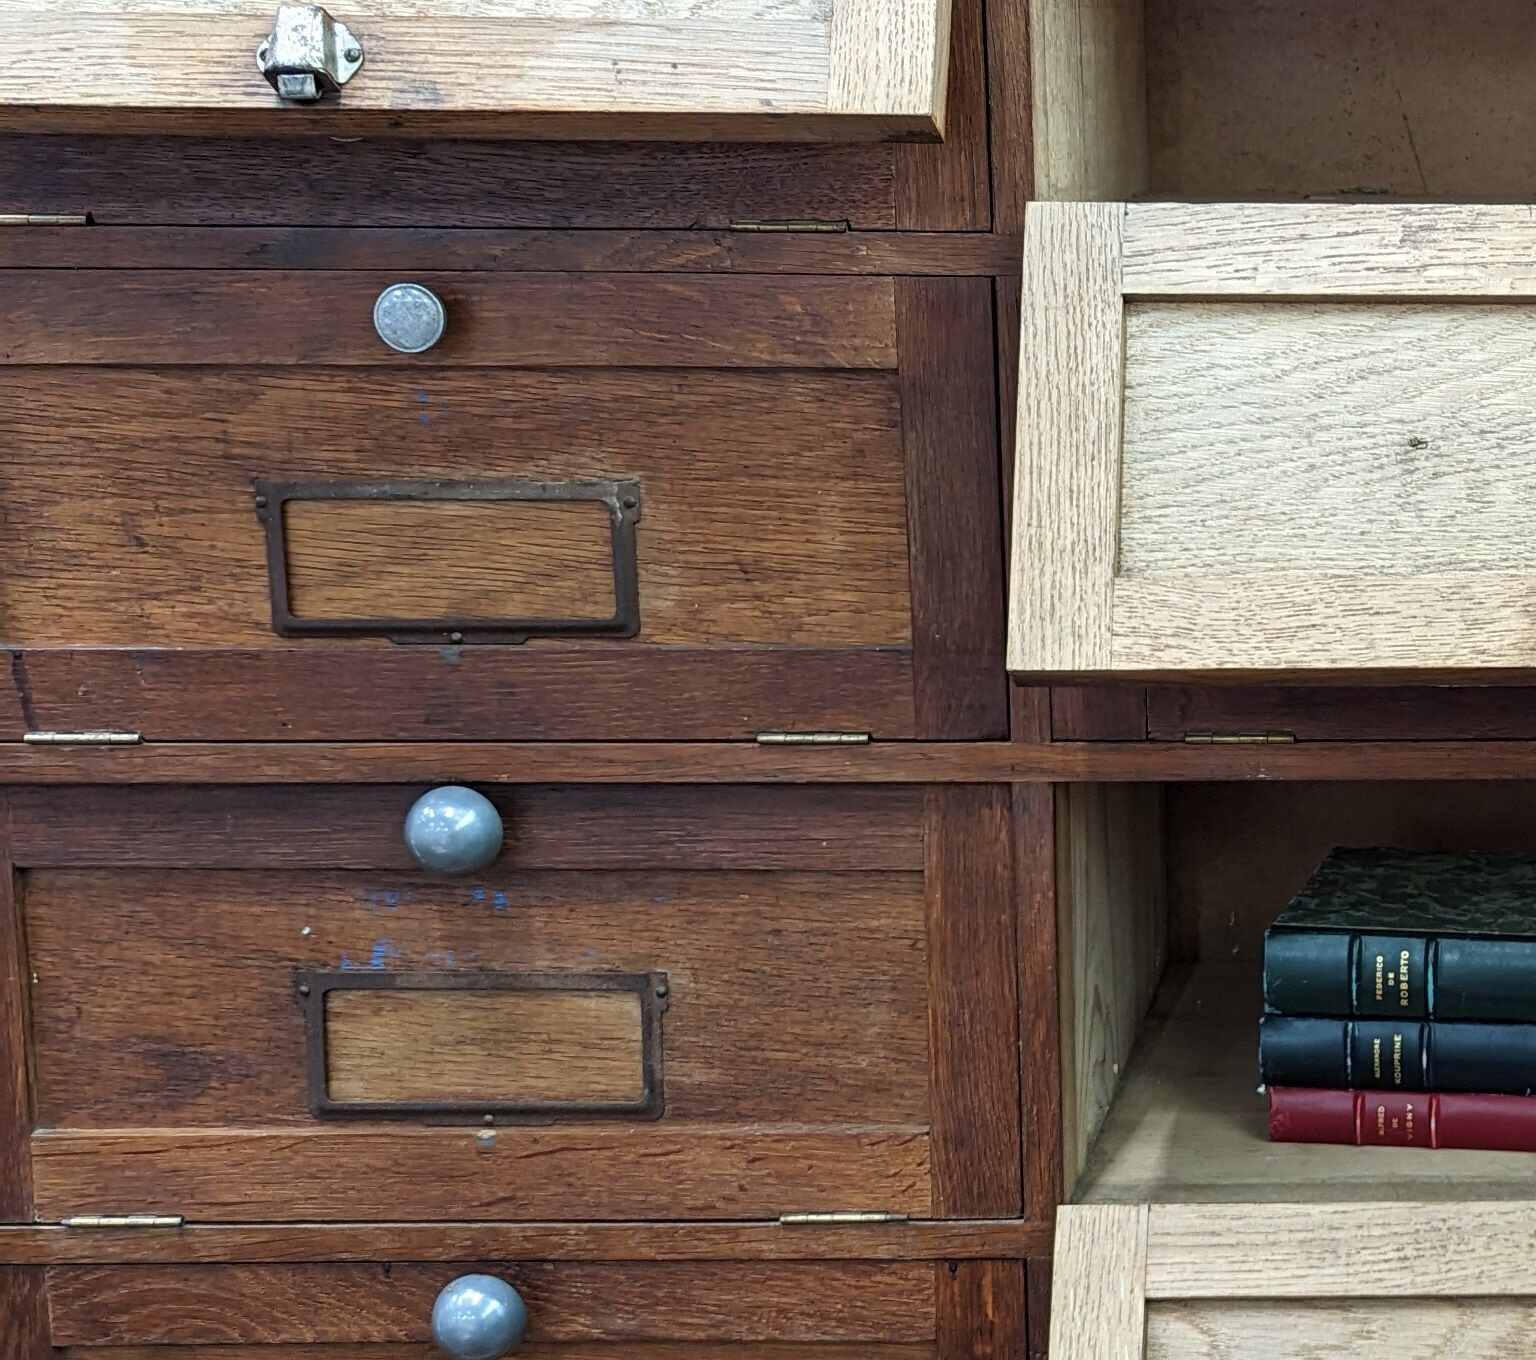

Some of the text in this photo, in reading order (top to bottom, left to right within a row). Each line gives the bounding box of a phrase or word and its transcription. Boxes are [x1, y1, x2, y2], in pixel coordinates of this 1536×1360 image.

[1376, 955, 1384, 1000] FEDERICO
[1387, 971, 1395, 986] DE
[1400, 950, 1410, 1006] ROBERTO
[1393, 1034, 1402, 1084] KOUPRINE
[1377, 1105, 1385, 1136] ALFRED
[1391, 1118, 1399, 1128] DE
